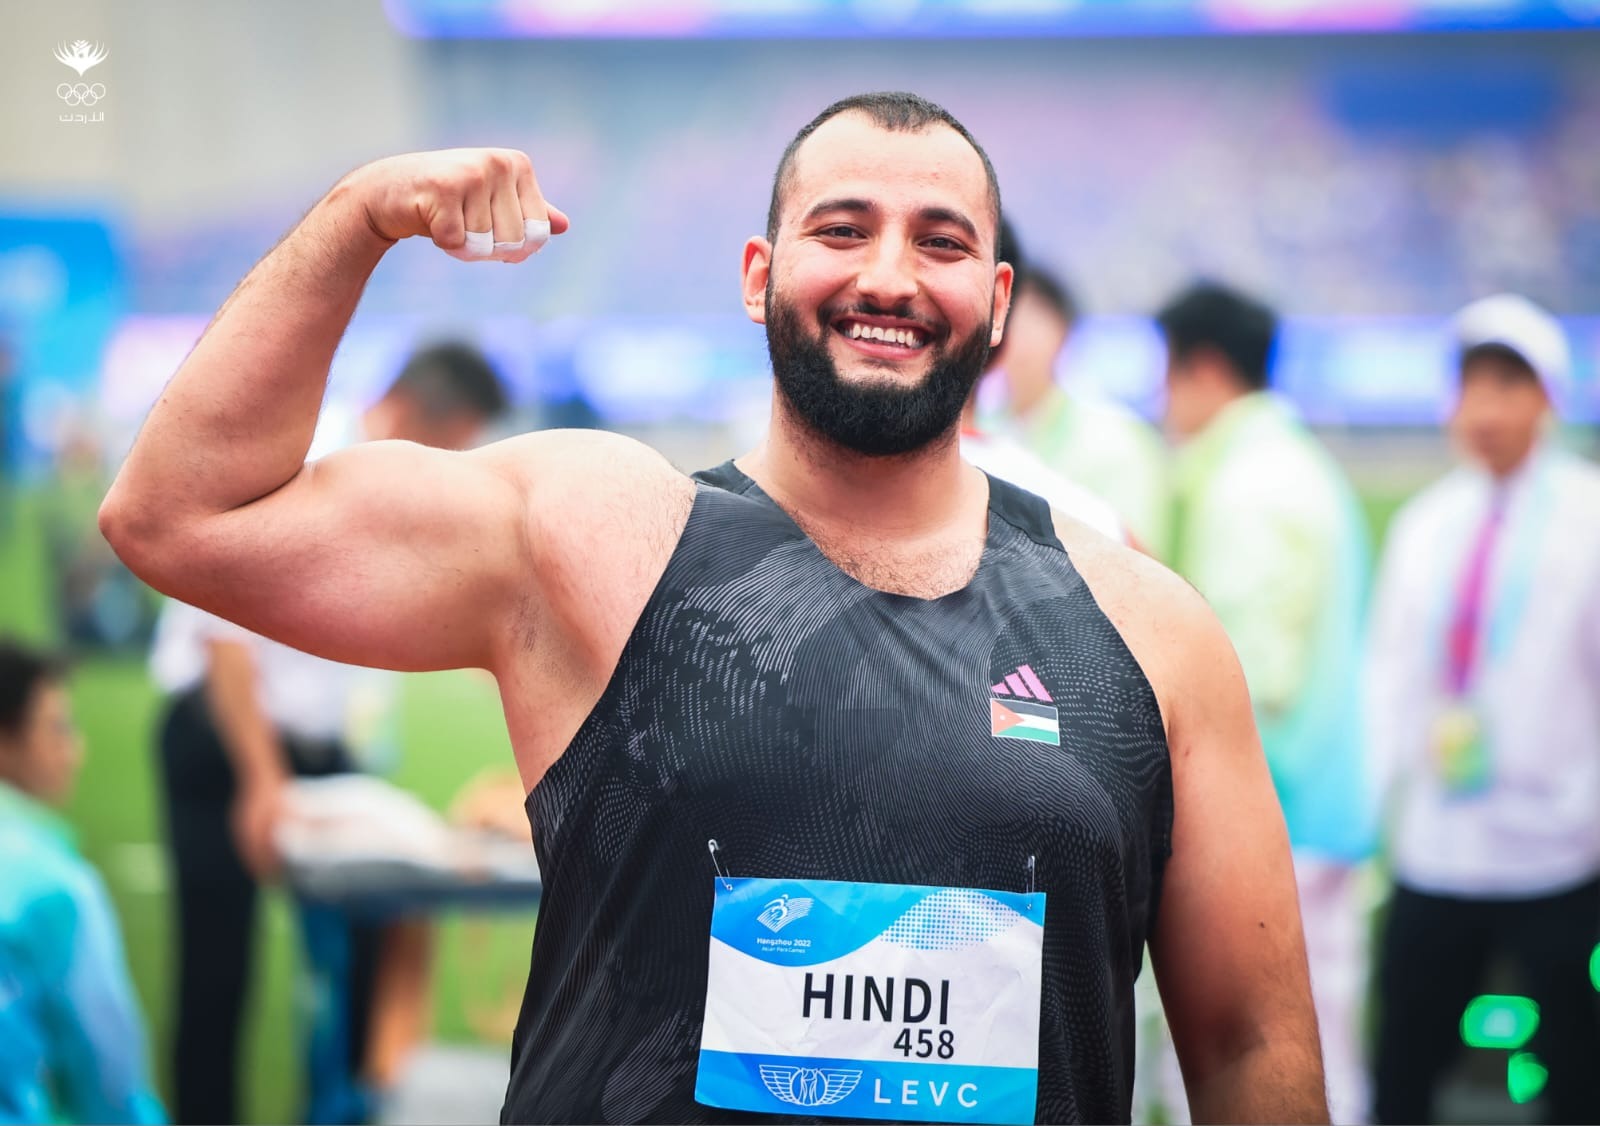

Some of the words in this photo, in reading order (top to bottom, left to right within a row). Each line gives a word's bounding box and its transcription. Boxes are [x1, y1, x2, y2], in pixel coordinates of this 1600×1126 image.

[757, 938, 793, 946] Hangzhou
[794, 939, 811, 947] 2022
[803, 972, 949, 1025] HINDI
[893, 1028, 954, 1059] 458
[874, 1078, 978, 1108] LEVC
